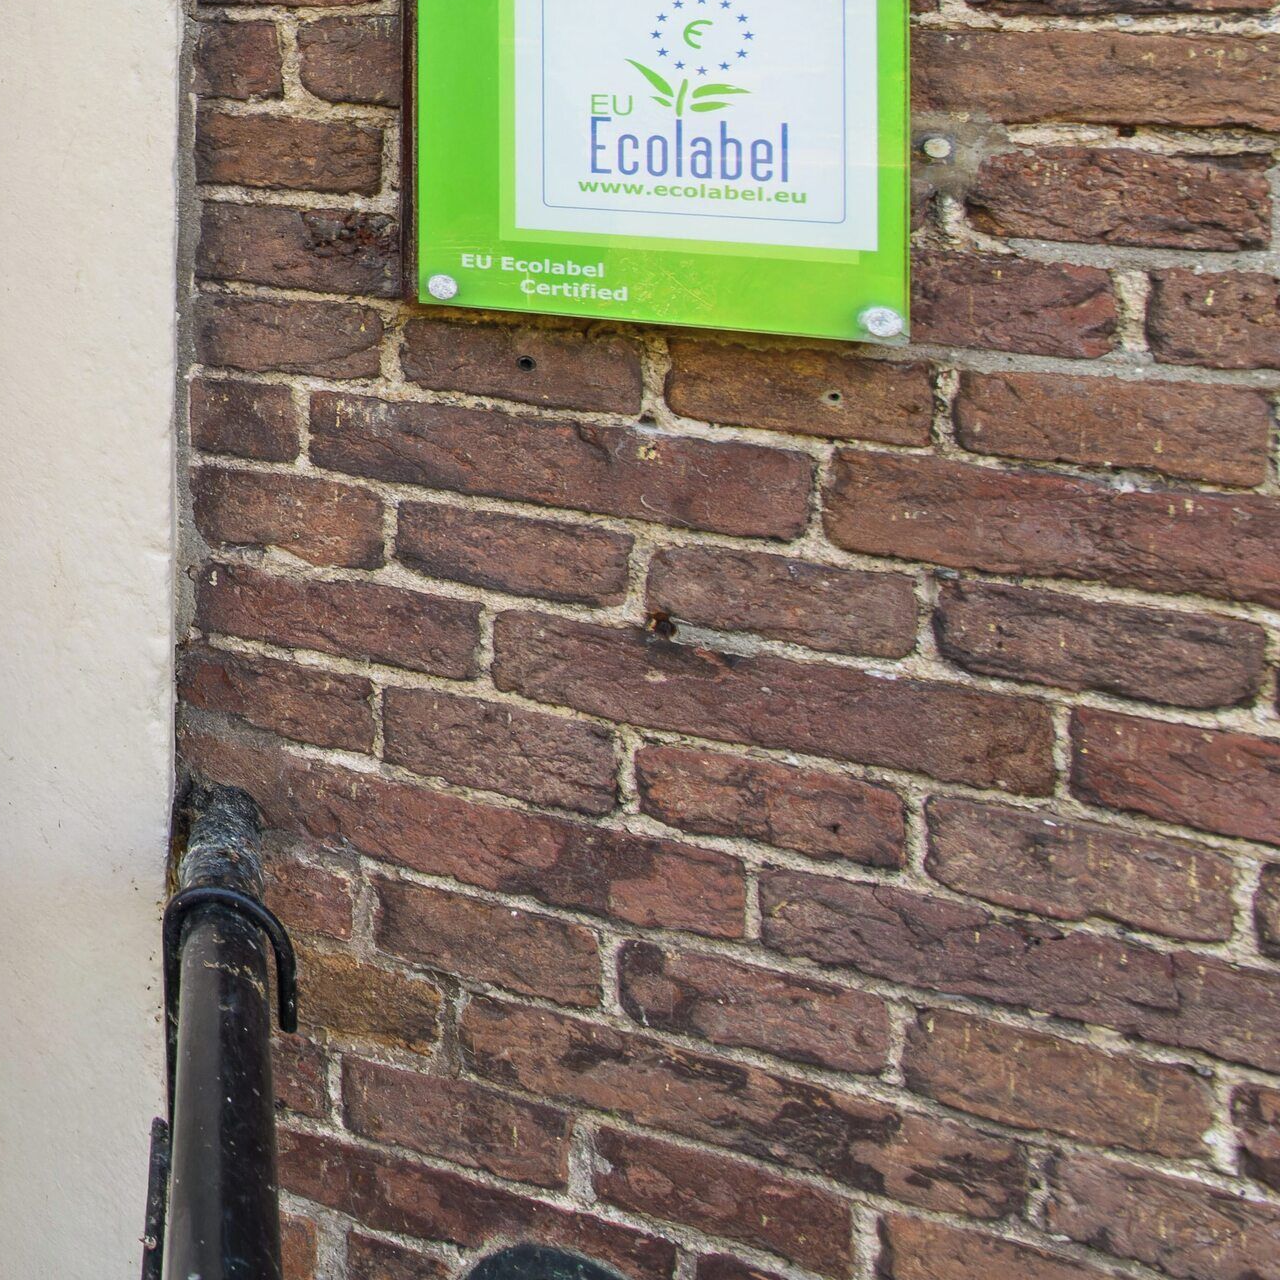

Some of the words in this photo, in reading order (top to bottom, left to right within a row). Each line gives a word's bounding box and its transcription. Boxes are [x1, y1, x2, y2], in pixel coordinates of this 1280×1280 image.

[590, 94, 633, 116] EU
[590, 116, 788, 183] Ecolabel
[578, 180, 807, 204] www.ecolabel.eu
[461, 253, 492, 270] EU
[501, 256, 605, 278] Ecolabel
[520, 279, 628, 302] Certified
